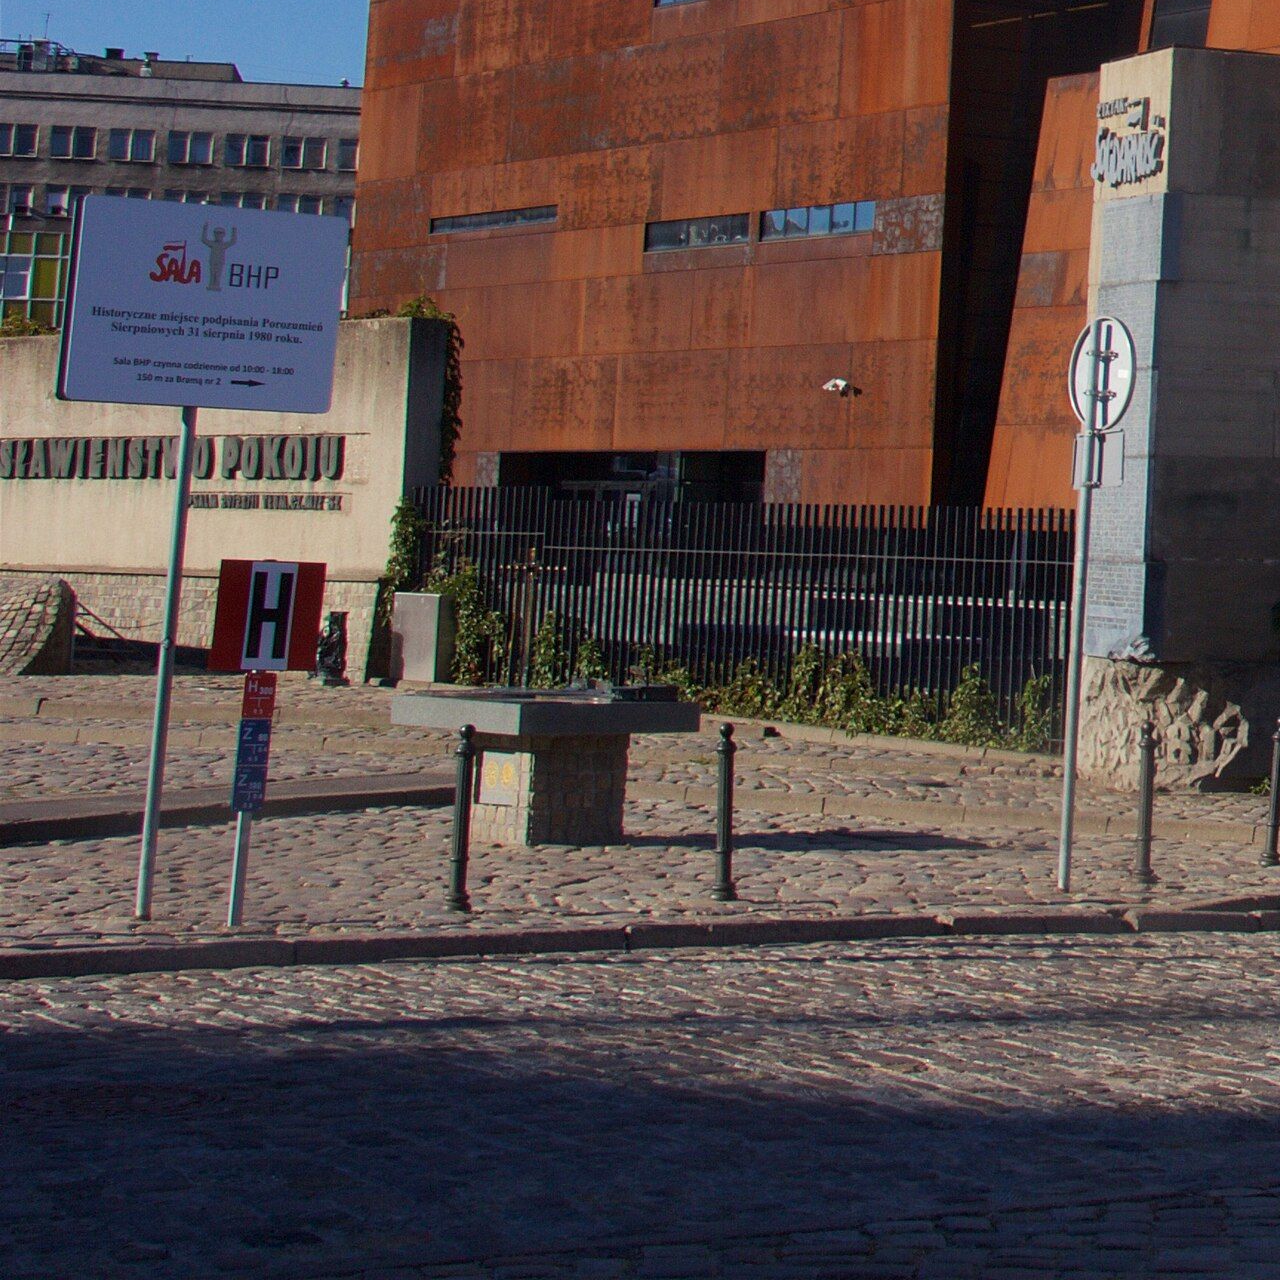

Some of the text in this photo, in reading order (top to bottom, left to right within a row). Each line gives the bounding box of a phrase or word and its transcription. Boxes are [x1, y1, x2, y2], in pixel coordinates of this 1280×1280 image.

[150, 248, 280, 290] SALA BHP
[92, 306, 323, 332] Historyczne miejsce podpisania Porozumień
[111, 322, 303, 344] Sierpniowych 31 sierpnia 1980 roku.
[113, 357, 132, 366] Sala
[133, 358, 152, 367] BHP
[153, 361, 182, 369] czynna
[183, 361, 228, 372] codziennie
[230, 364, 241, 372] od
[136, 373, 154, 382] 150
[220, 435, 346, 481] POKOJU
[245, 570, 294, 660] H
[248, 680, 259, 693] H
